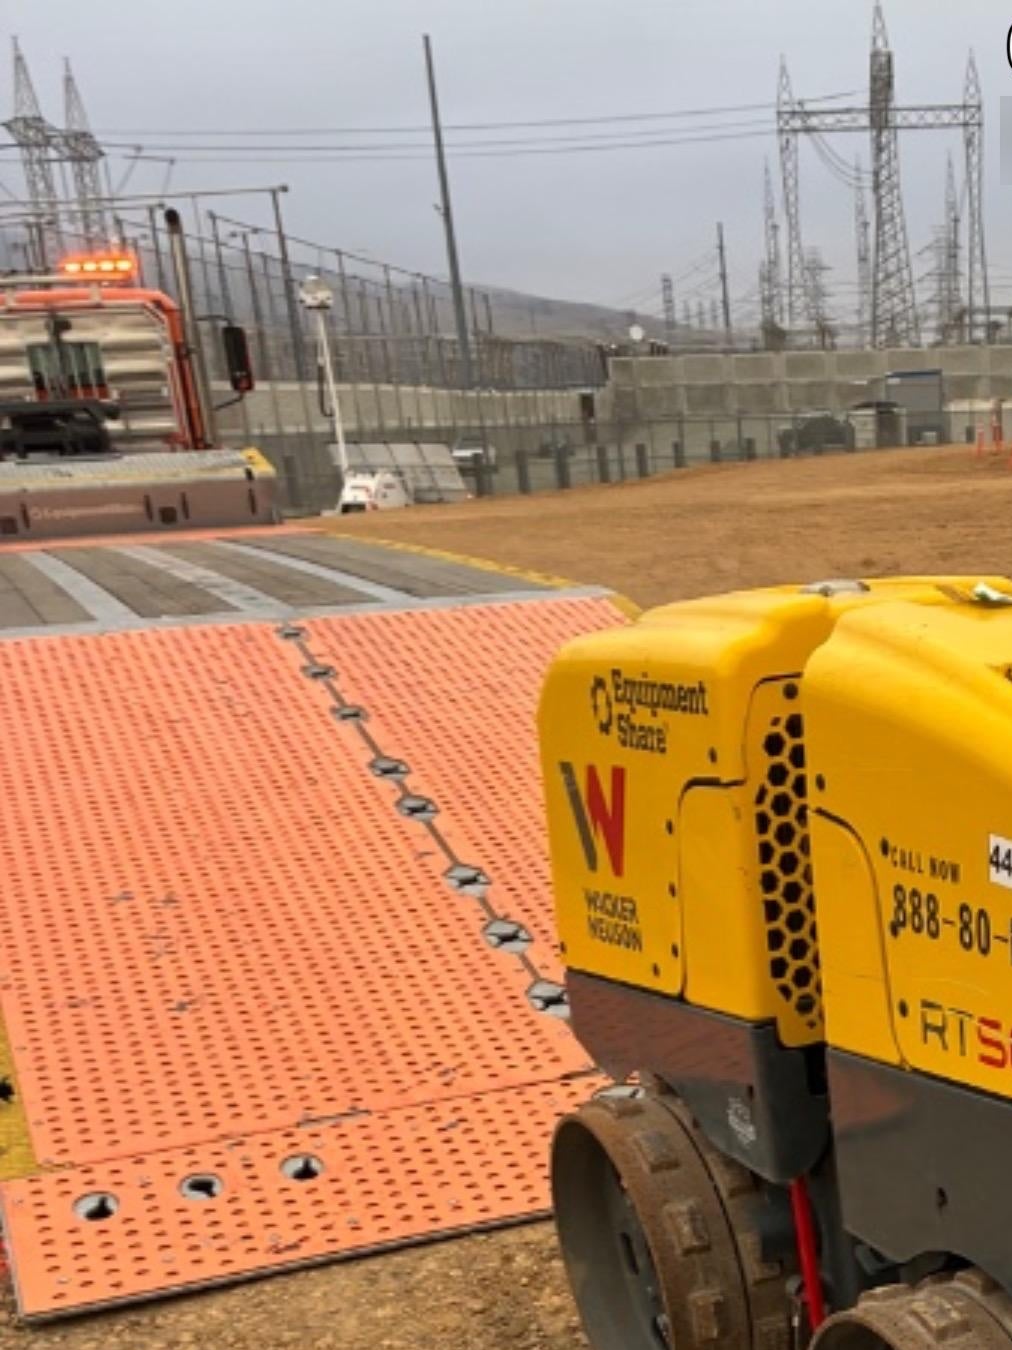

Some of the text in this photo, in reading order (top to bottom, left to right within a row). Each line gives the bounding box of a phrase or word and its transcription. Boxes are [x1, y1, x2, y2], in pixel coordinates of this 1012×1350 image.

[611, 668, 708, 717] Equipment
[617, 712, 667, 754] Share
[890, 847, 961, 884] CALL NOW
